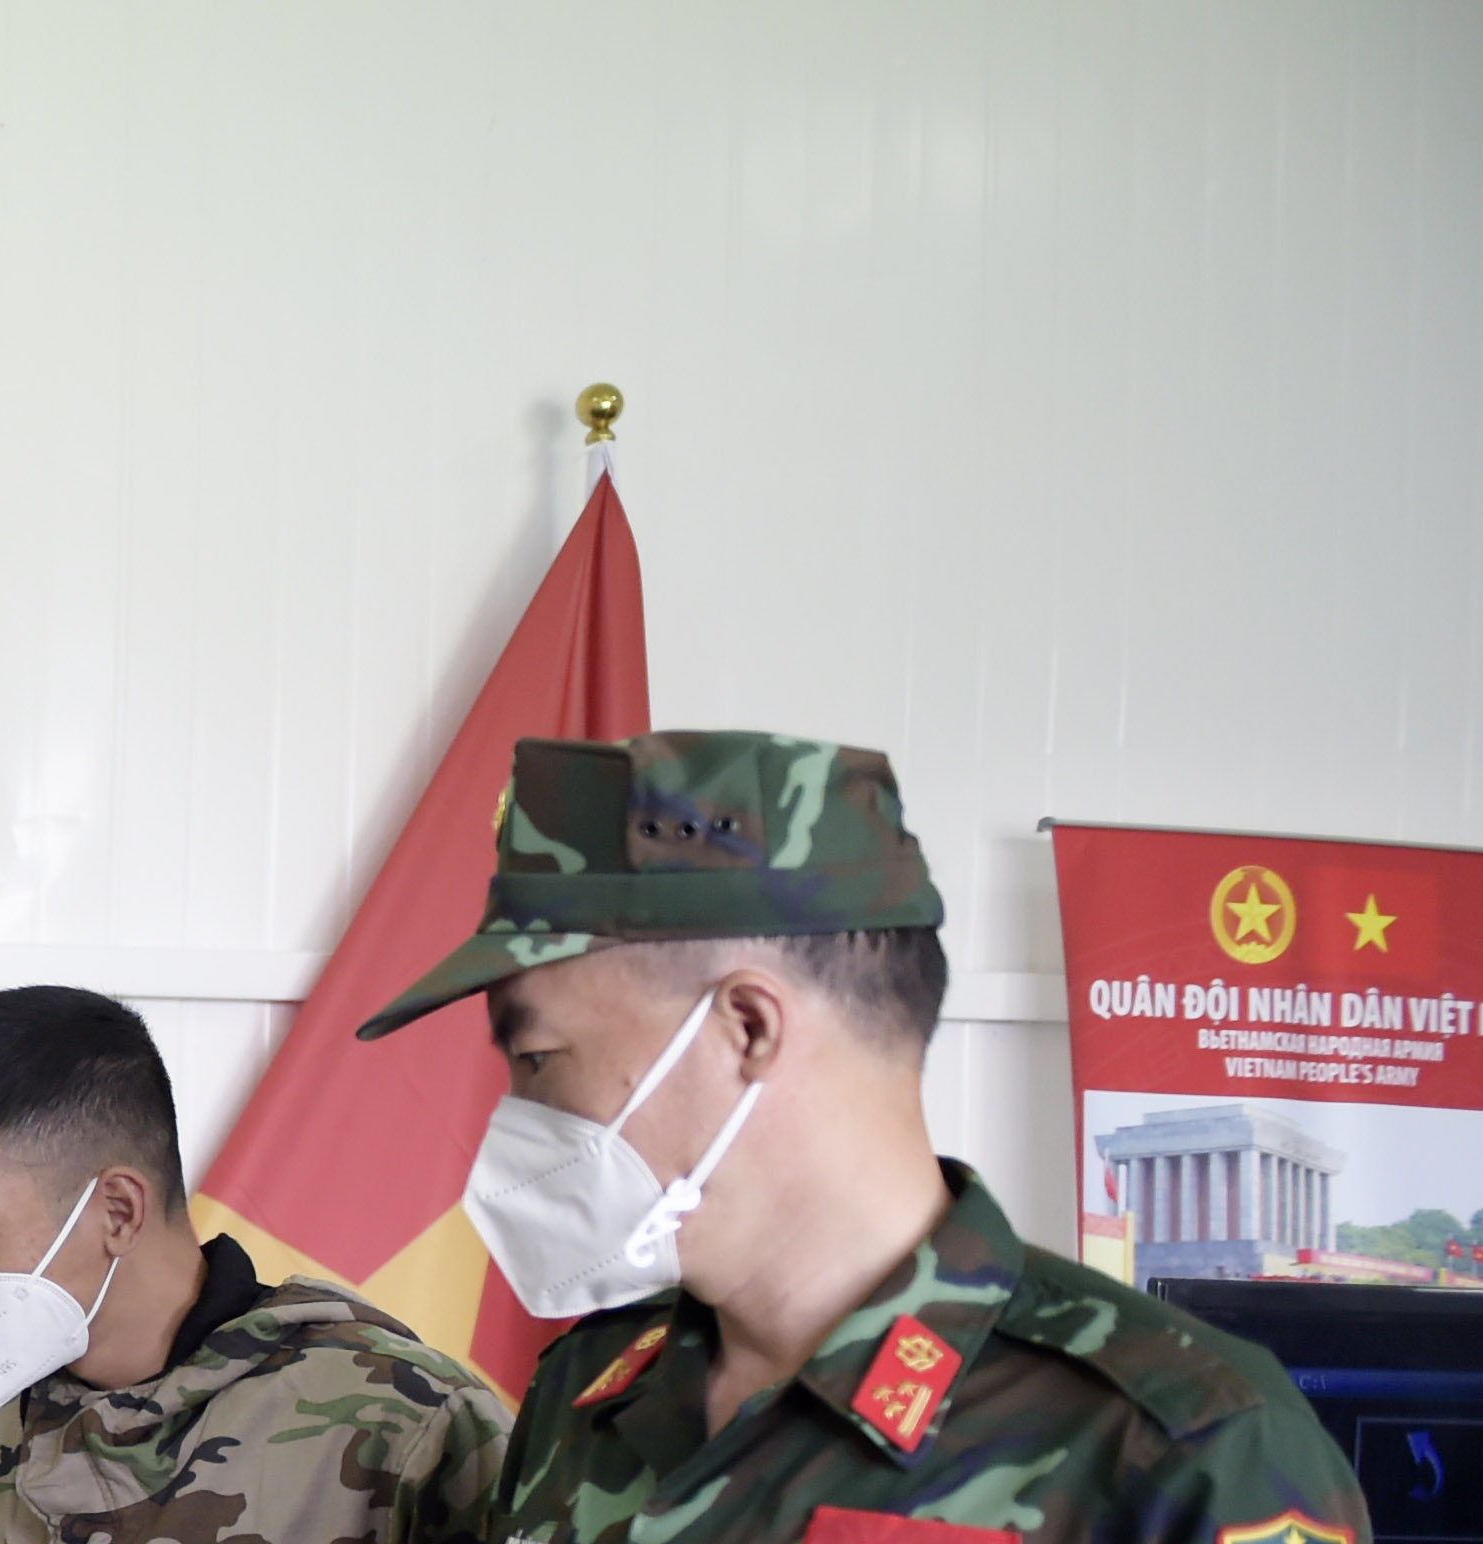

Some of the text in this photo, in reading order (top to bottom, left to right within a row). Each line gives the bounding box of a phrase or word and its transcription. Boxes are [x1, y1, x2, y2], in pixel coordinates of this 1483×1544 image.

[1089, 974, 1176, 1020] QUÂN
[1182, 978, 1239, 1025] ĐỘI
[1248, 983, 1332, 1027] NHÂN
[1340, 987, 1403, 1031] DÂN
[1408, 992, 1474, 1038] VIỆT
[1198, 1028, 1444, 1062] ВЬЕТНАМСКАЯ НАРОДНАЯ АРМИЯ
[1225, 1057, 1297, 1081] VIETNAM
[1375, 1065, 1420, 1087] ARMY
